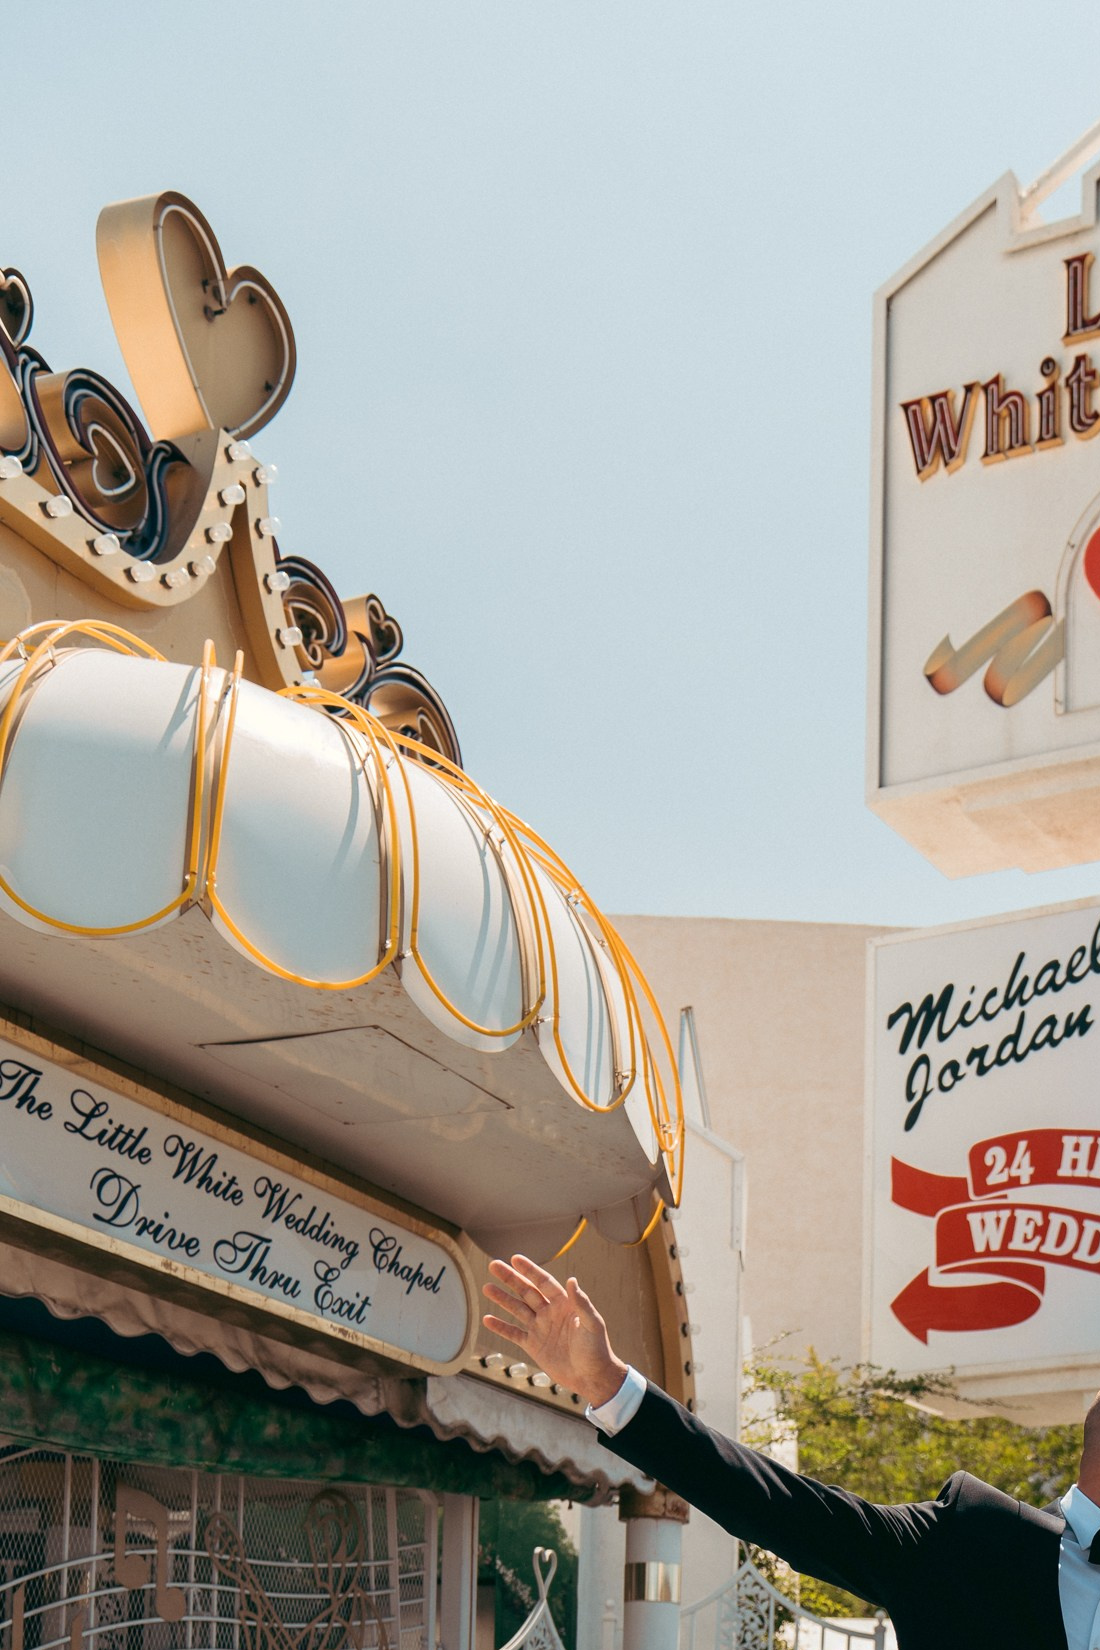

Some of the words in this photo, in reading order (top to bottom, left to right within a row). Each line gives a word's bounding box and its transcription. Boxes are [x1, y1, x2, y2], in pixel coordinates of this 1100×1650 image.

[904, 1004, 1094, 1132] Jordan
[0, 1058, 53, 1120] The
[64, 1088, 152, 1165] Little
[163, 1134, 244, 1206] White
[254, 1176, 359, 1270] Wedding
[368, 1227, 446, 1295] Chapel
[984, 1144, 1034, 1186] 24
[90, 1168, 200, 1258] Drive
[213, 1230, 301, 1299] Thru
[313, 1259, 372, 1325] Exit
